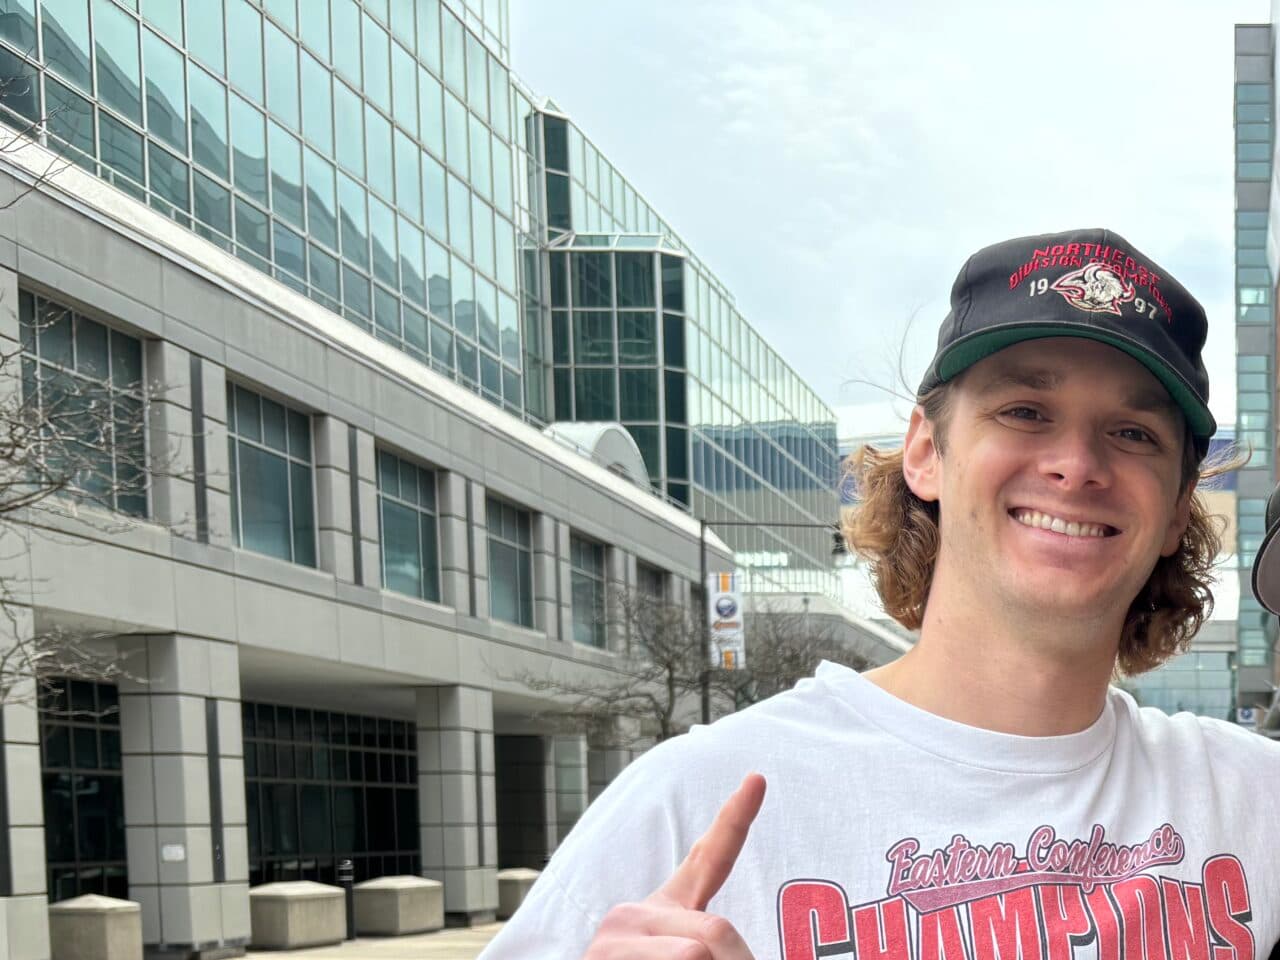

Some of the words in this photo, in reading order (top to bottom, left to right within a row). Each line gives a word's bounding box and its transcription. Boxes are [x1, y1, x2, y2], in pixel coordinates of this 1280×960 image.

[1009, 256, 1083, 291] DIVISION
[1032, 242, 1161, 284] NORTHEAST
[1029, 278, 1049, 297] 19
[1135, 298, 1158, 320] 97
[887, 834, 1018, 895] Eastern
[1028, 823, 1186, 893] Conference
